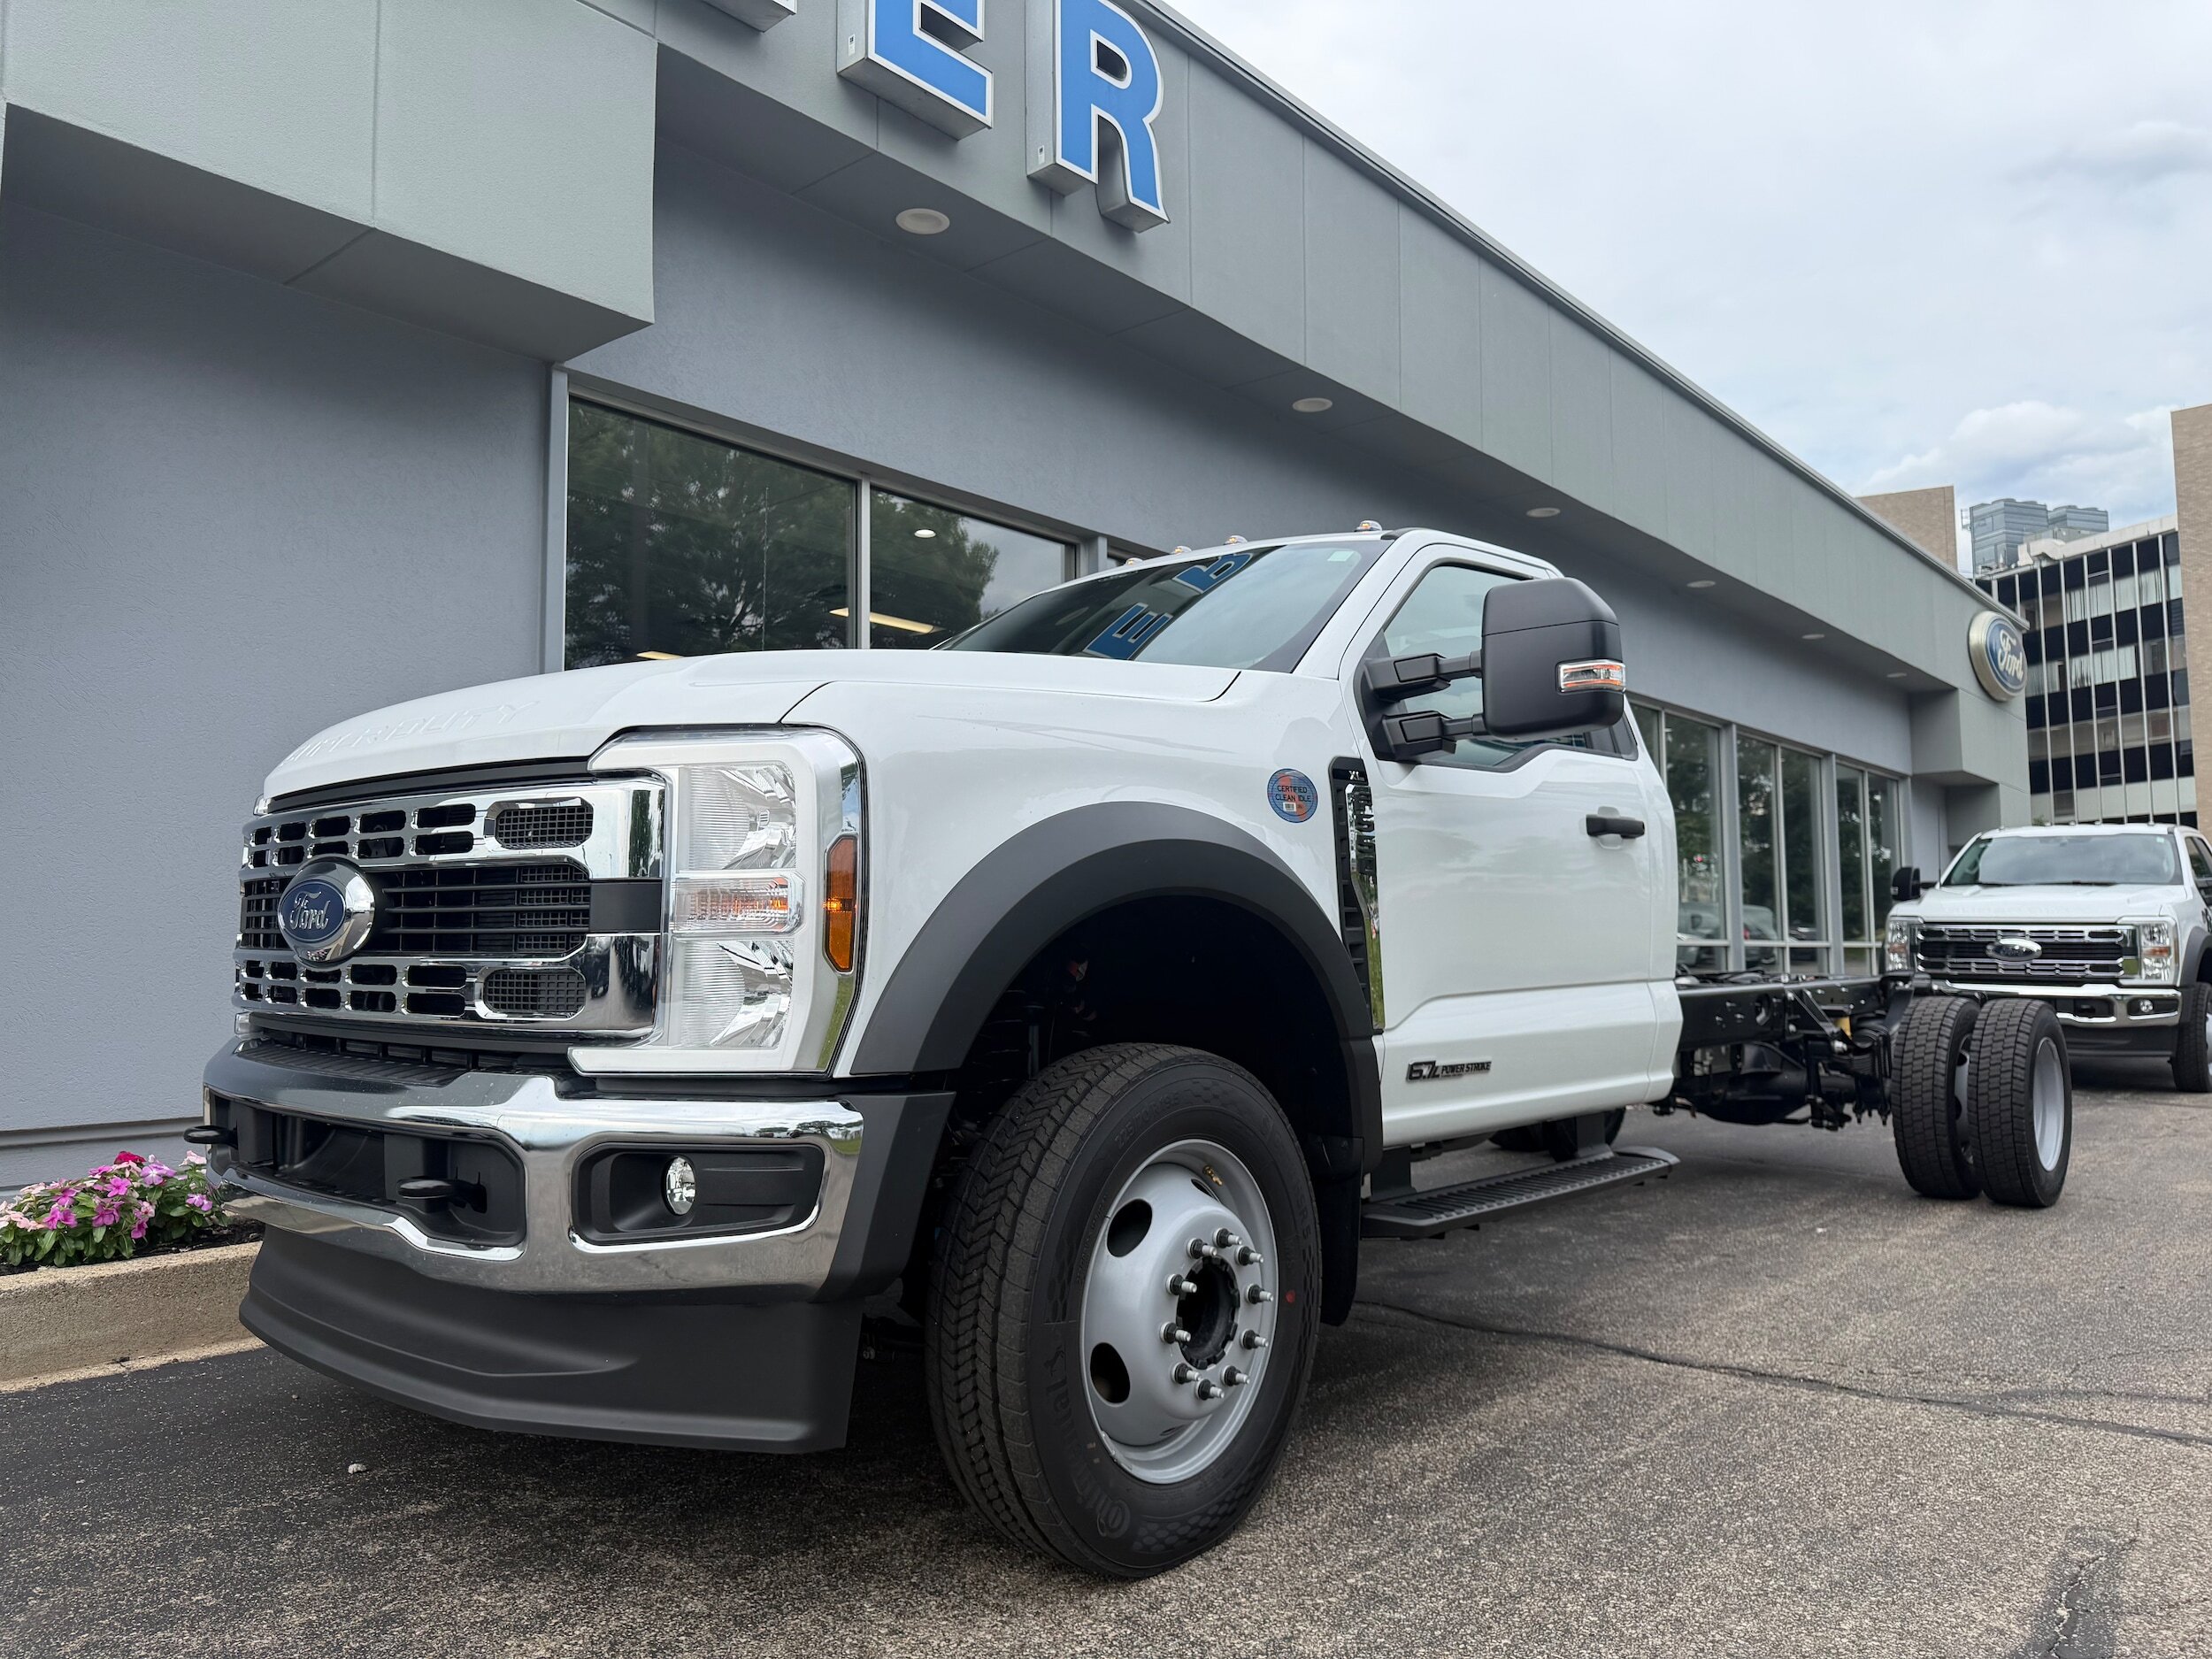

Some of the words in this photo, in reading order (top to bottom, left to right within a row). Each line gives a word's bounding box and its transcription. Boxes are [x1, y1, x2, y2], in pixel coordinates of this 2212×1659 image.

[774, 0, 1171, 223] ER
[1998, 629, 2024, 681] Ford
[1348, 770, 1365, 781] XL
[1275, 793, 1296, 802] CLEAN
[1277, 785, 1308, 794] CERTIFIED
[289, 890, 331, 930] Ford
[1407, 1060, 1440, 1080] 6.7L
[1440, 1064, 1465, 1075] POWER
[1464, 1062, 1492, 1072] STROKE
